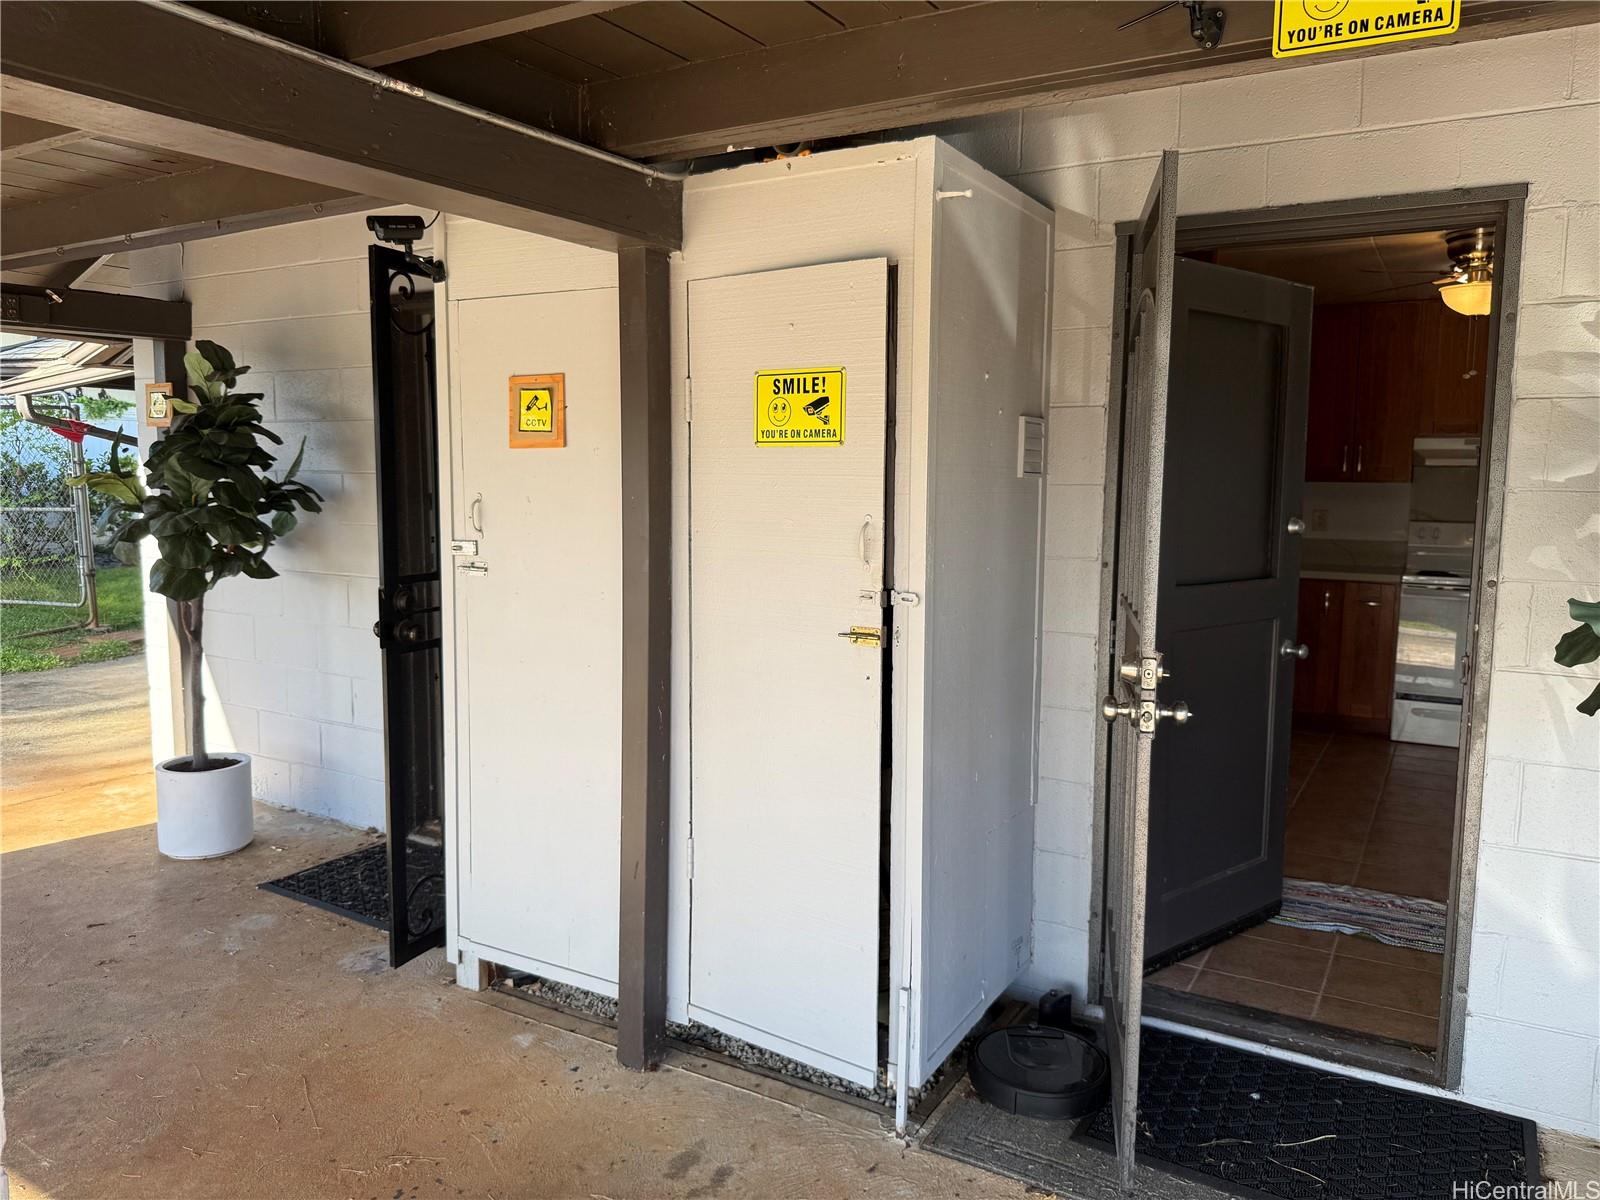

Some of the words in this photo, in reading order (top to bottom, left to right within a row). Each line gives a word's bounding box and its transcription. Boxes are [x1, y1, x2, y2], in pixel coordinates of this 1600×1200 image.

[1287, 22, 1344, 44] YOU'RE
[1348, 20, 1371, 35] ON
[1374, 7, 1445, 31] CAMERA
[773, 377, 826, 395] SMILE!
[525, 418, 547, 427] CCTV
[761, 429, 789, 439] YOU'RE
[790, 429, 801, 438] ON
[803, 429, 837, 438] CAMERA
